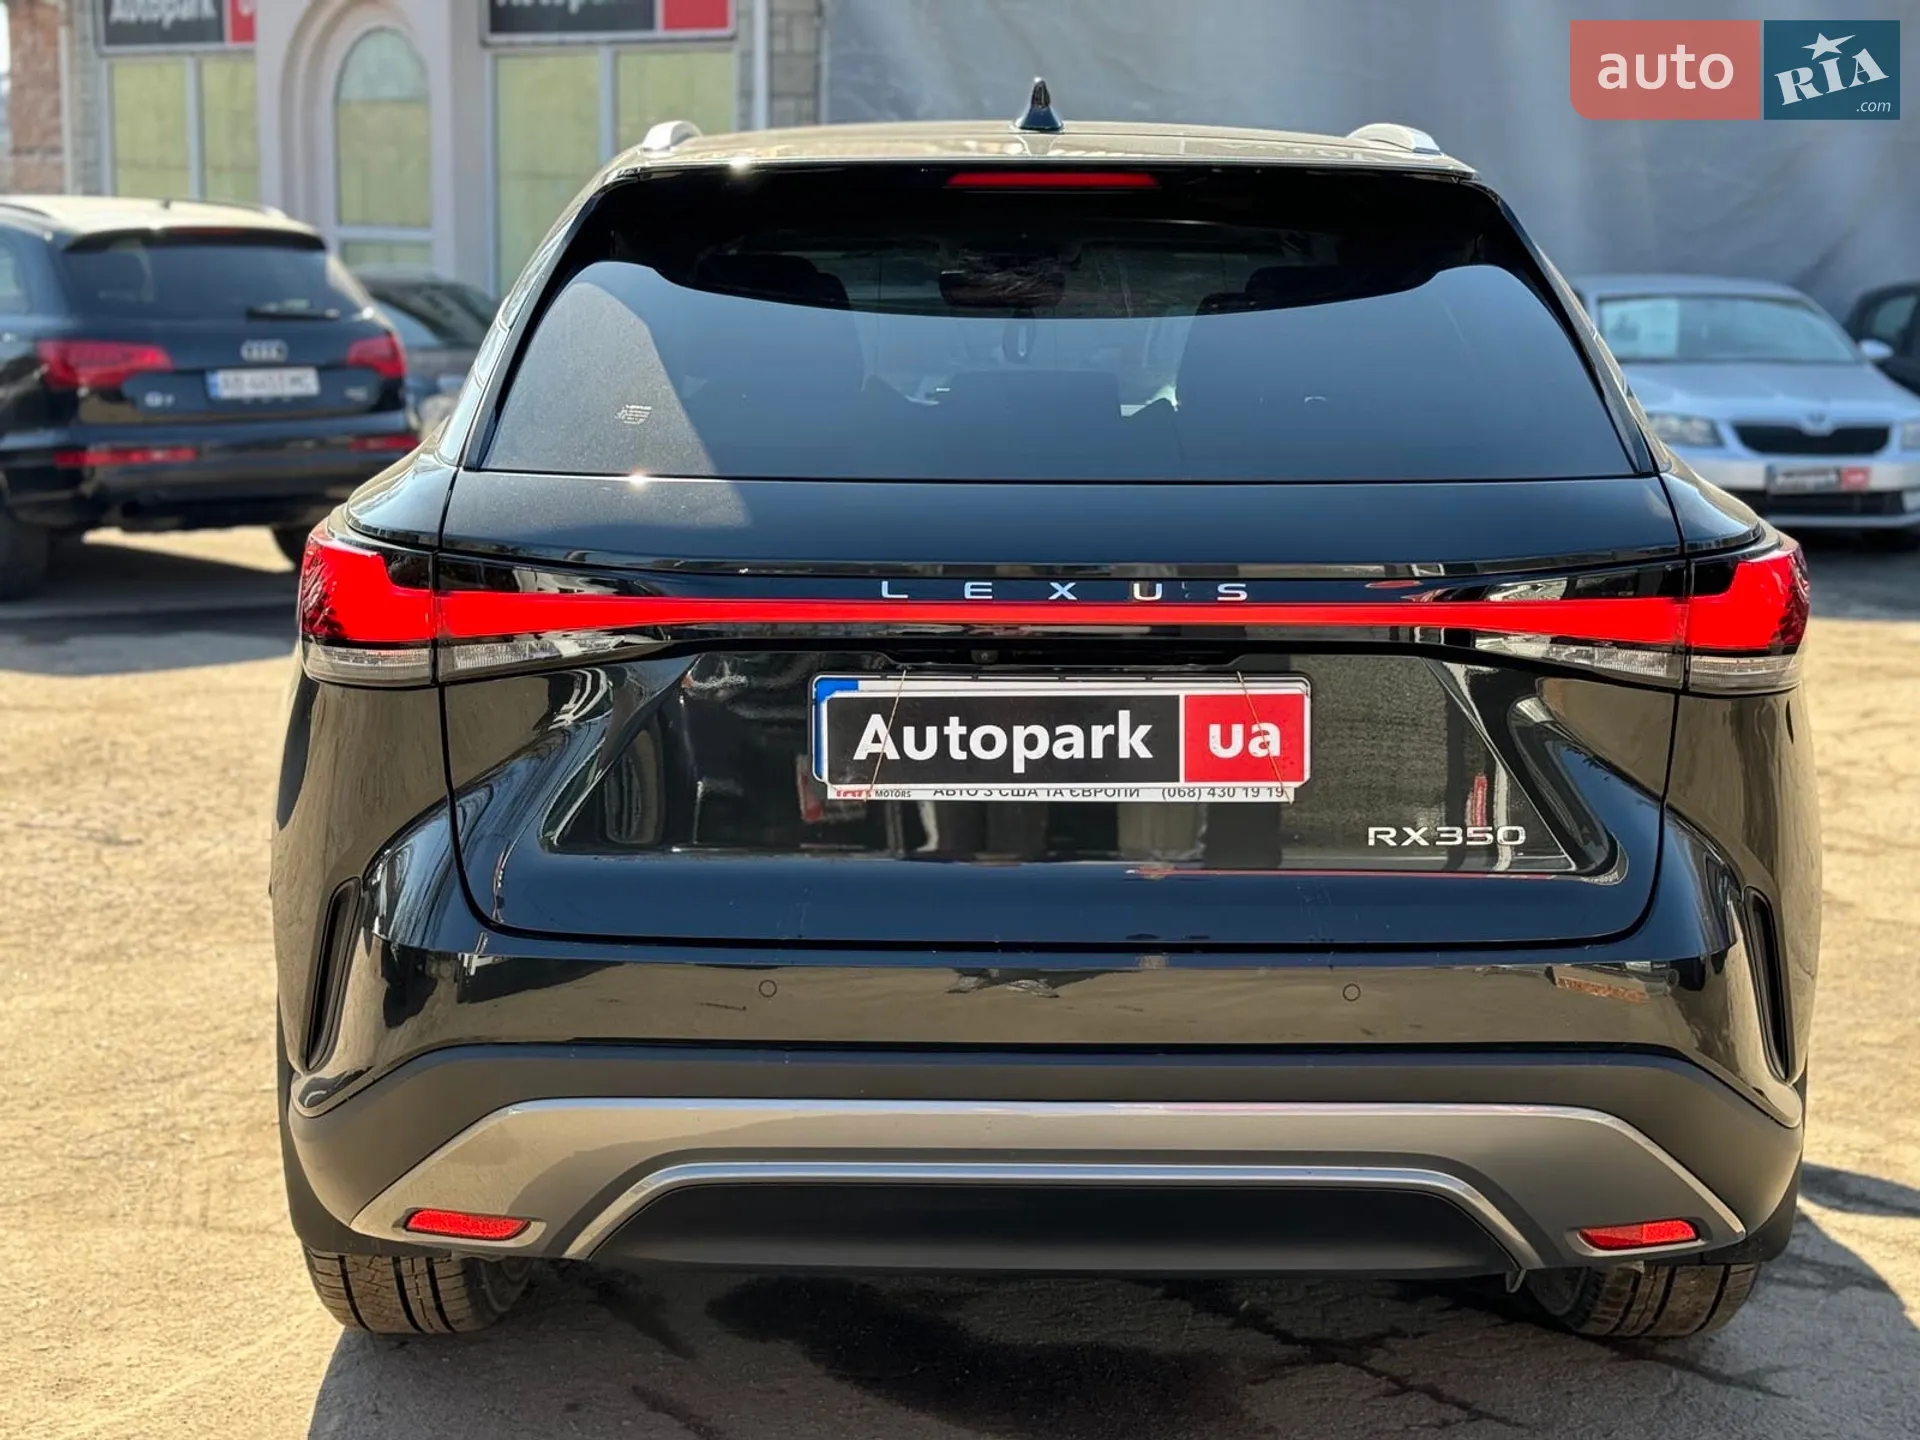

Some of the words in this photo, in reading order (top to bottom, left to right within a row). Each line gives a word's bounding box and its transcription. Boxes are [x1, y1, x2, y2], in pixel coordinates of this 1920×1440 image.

[881, 581, 1248, 601] LEXUS
[852, 709, 1153, 773] Autopark
[1207, 721, 1281, 759] ua
[874, 789, 912, 798] MOTORS
[1161, 786, 1202, 801] (068)
[1206, 786, 1236, 798] 430
[1243, 786, 1261, 798] 19
[1266, 786, 1285, 798] 19
